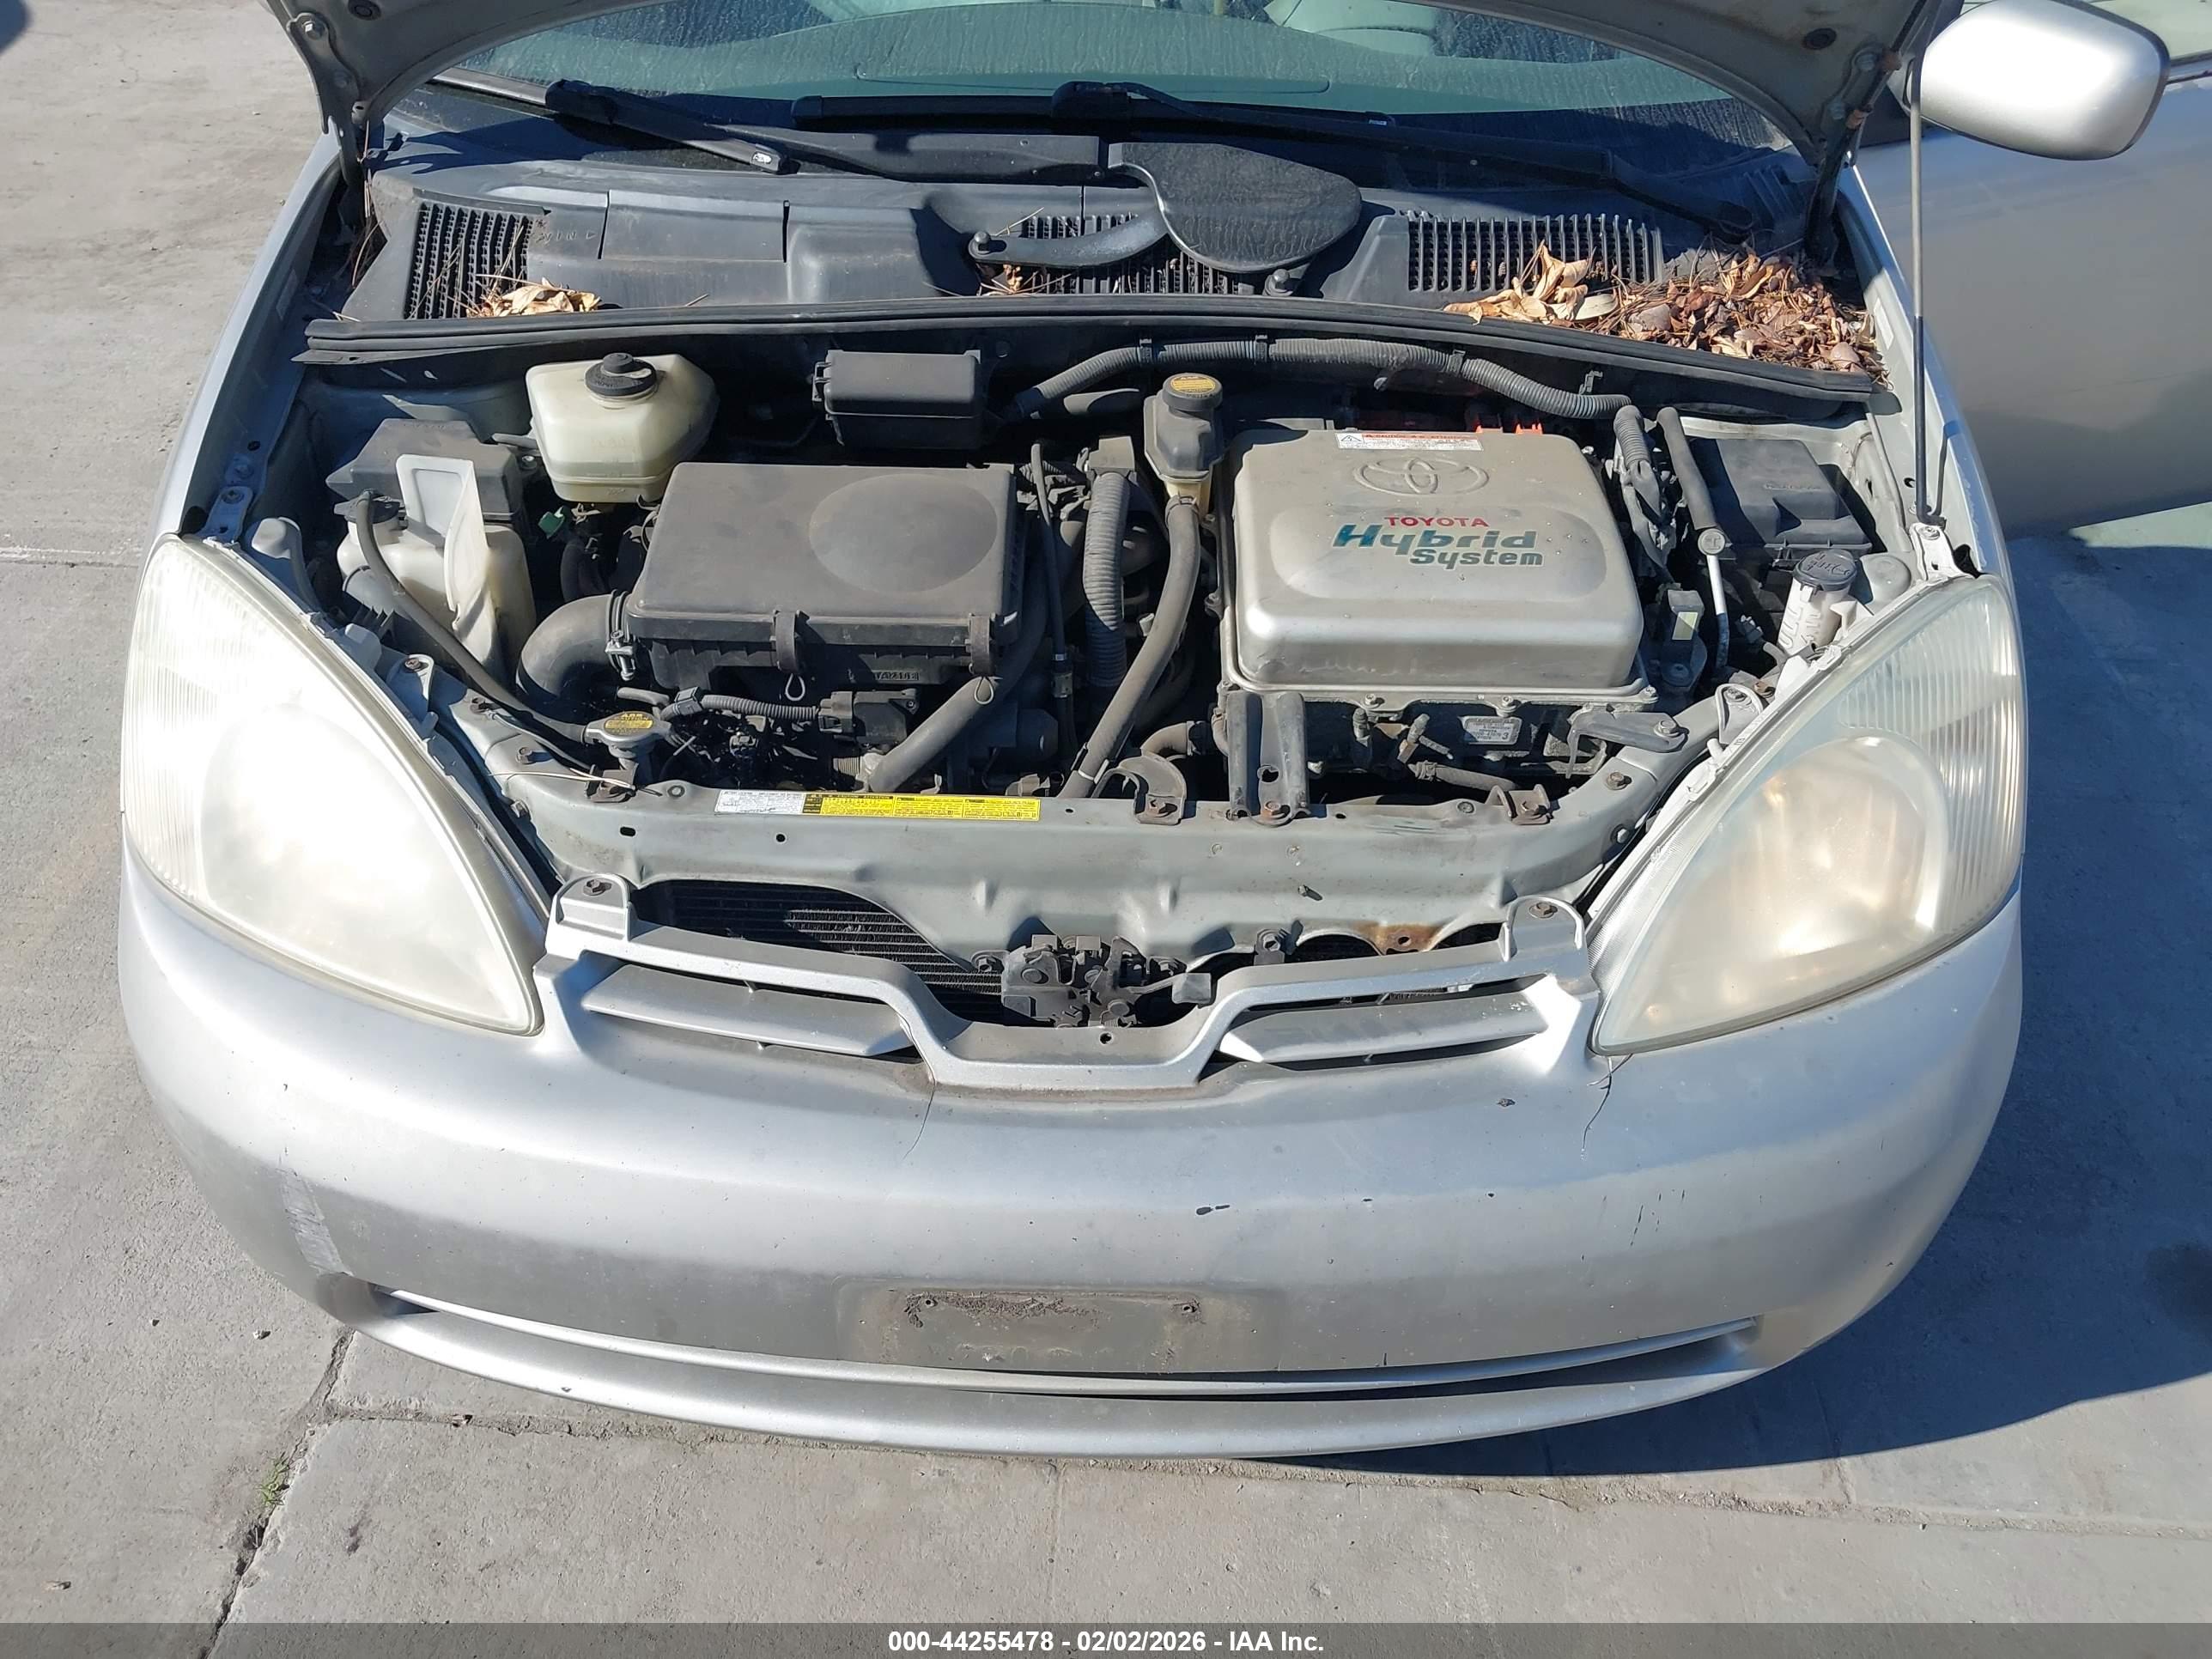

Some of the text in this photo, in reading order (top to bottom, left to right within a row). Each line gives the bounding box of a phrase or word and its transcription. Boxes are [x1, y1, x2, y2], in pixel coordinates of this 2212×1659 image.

[1384, 517, 1489, 527] TOYOTA
[1332, 524, 1537, 556] Hybrid
[1409, 548, 1544, 570] System
